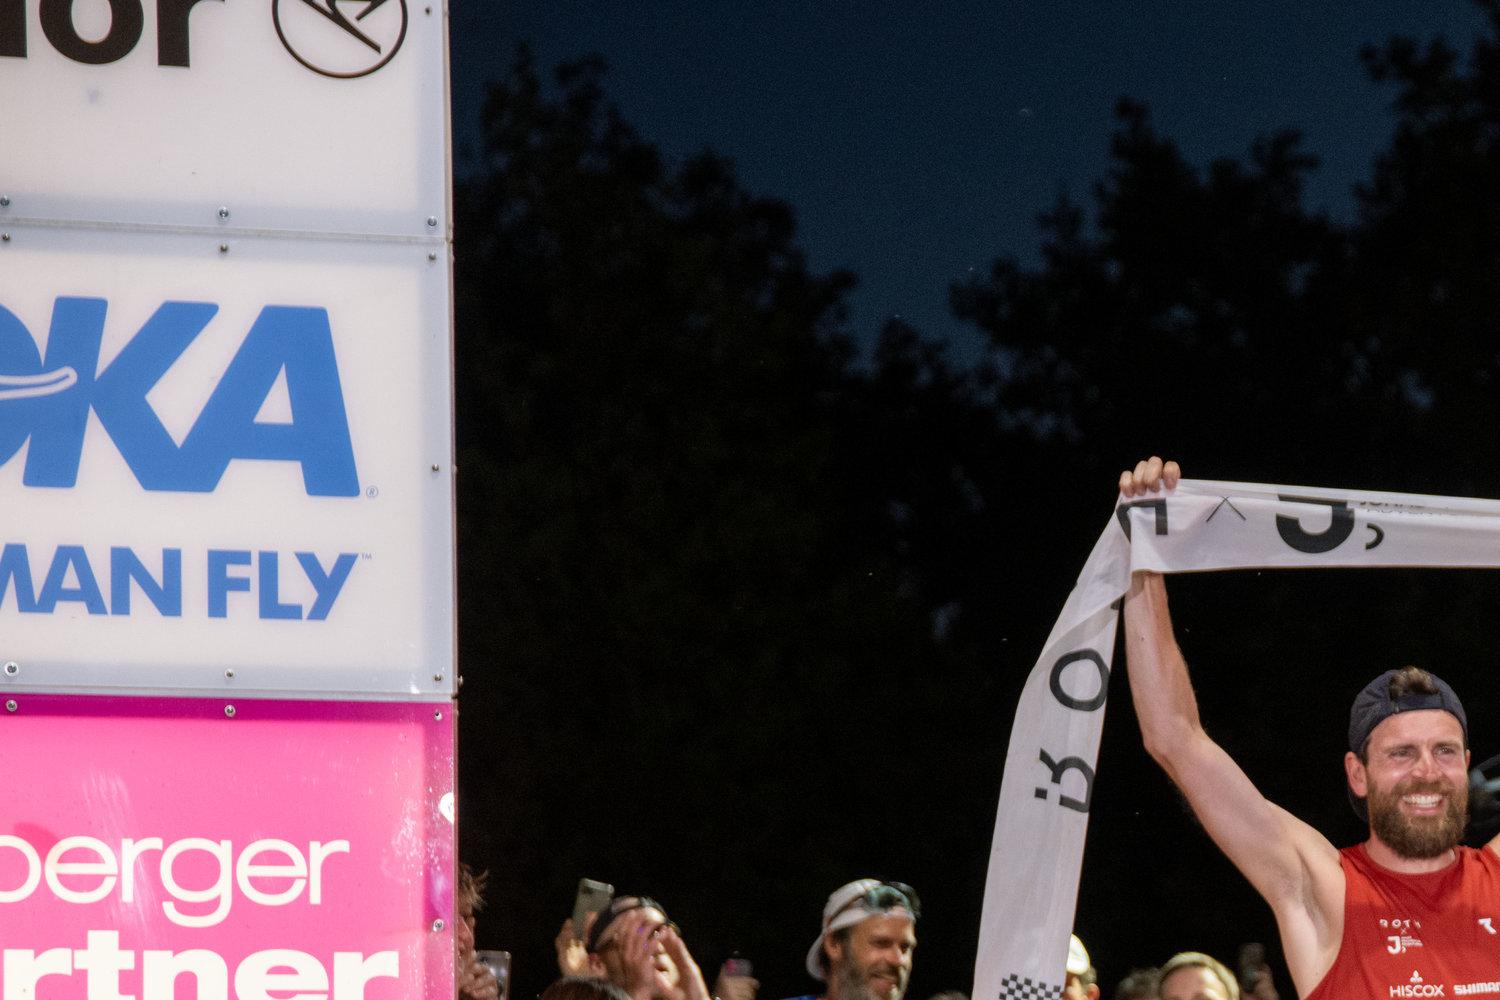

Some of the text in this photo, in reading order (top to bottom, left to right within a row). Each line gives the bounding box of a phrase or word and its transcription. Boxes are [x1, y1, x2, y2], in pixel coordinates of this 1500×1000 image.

[0, 0, 225, 68] or
[0, 296, 360, 497] KA
[207, 548, 359, 620] FLY
[1390, 985, 1445, 998] HISCOX
